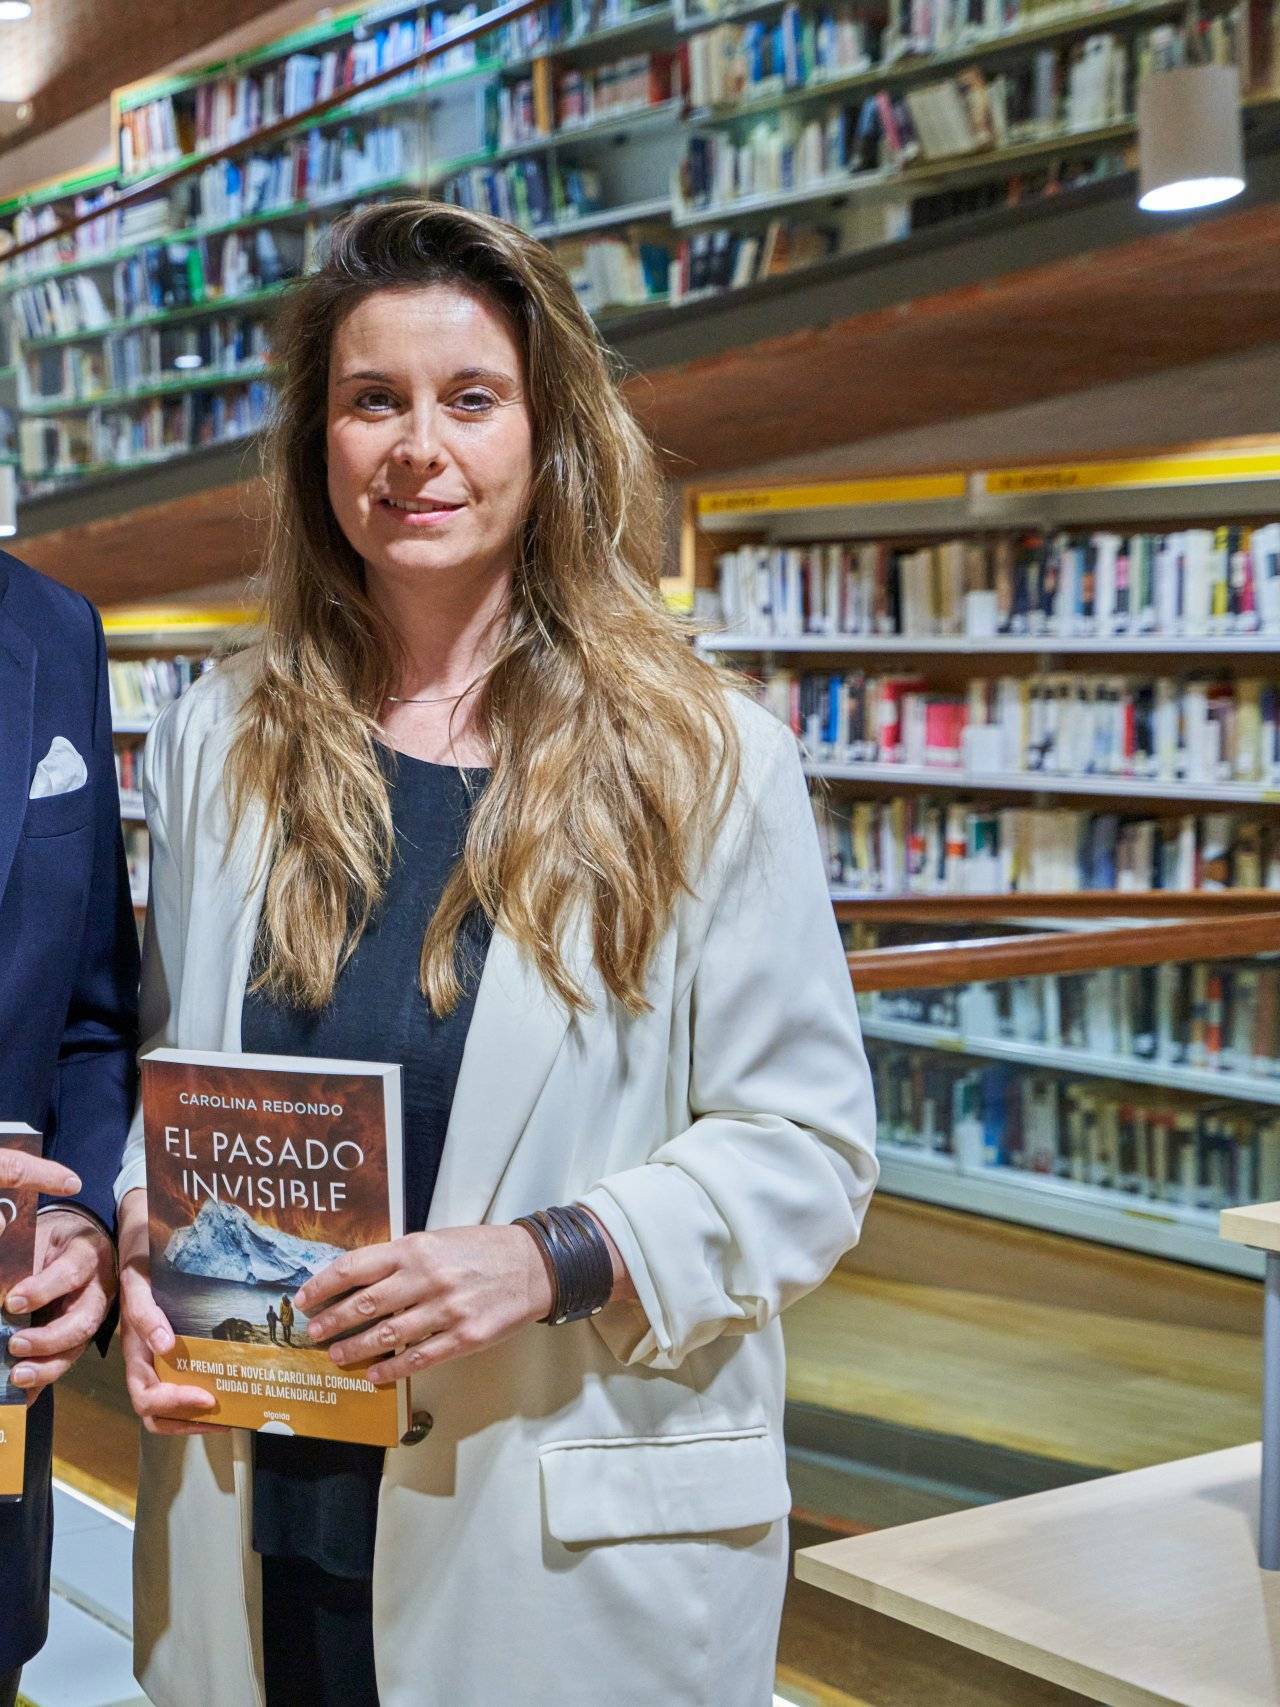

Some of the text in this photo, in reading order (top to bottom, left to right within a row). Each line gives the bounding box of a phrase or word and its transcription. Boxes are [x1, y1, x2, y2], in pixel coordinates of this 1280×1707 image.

[179, 1092, 343, 1117] CAROLINA REDONDO
[164, 1126, 364, 1171] EL PASADO
[182, 1169, 347, 1212] INVISIBLE
[176, 1357, 189, 1372] XX
[190, 1359, 224, 1376] PREMIO
[226, 1363, 238, 1378] DE
[240, 1365, 275, 1382] NOVELA
[277, 1370, 323, 1387] CAROLINA
[216, 1378, 337, 1405] CIUDAD DE ALMENDRALEJO
